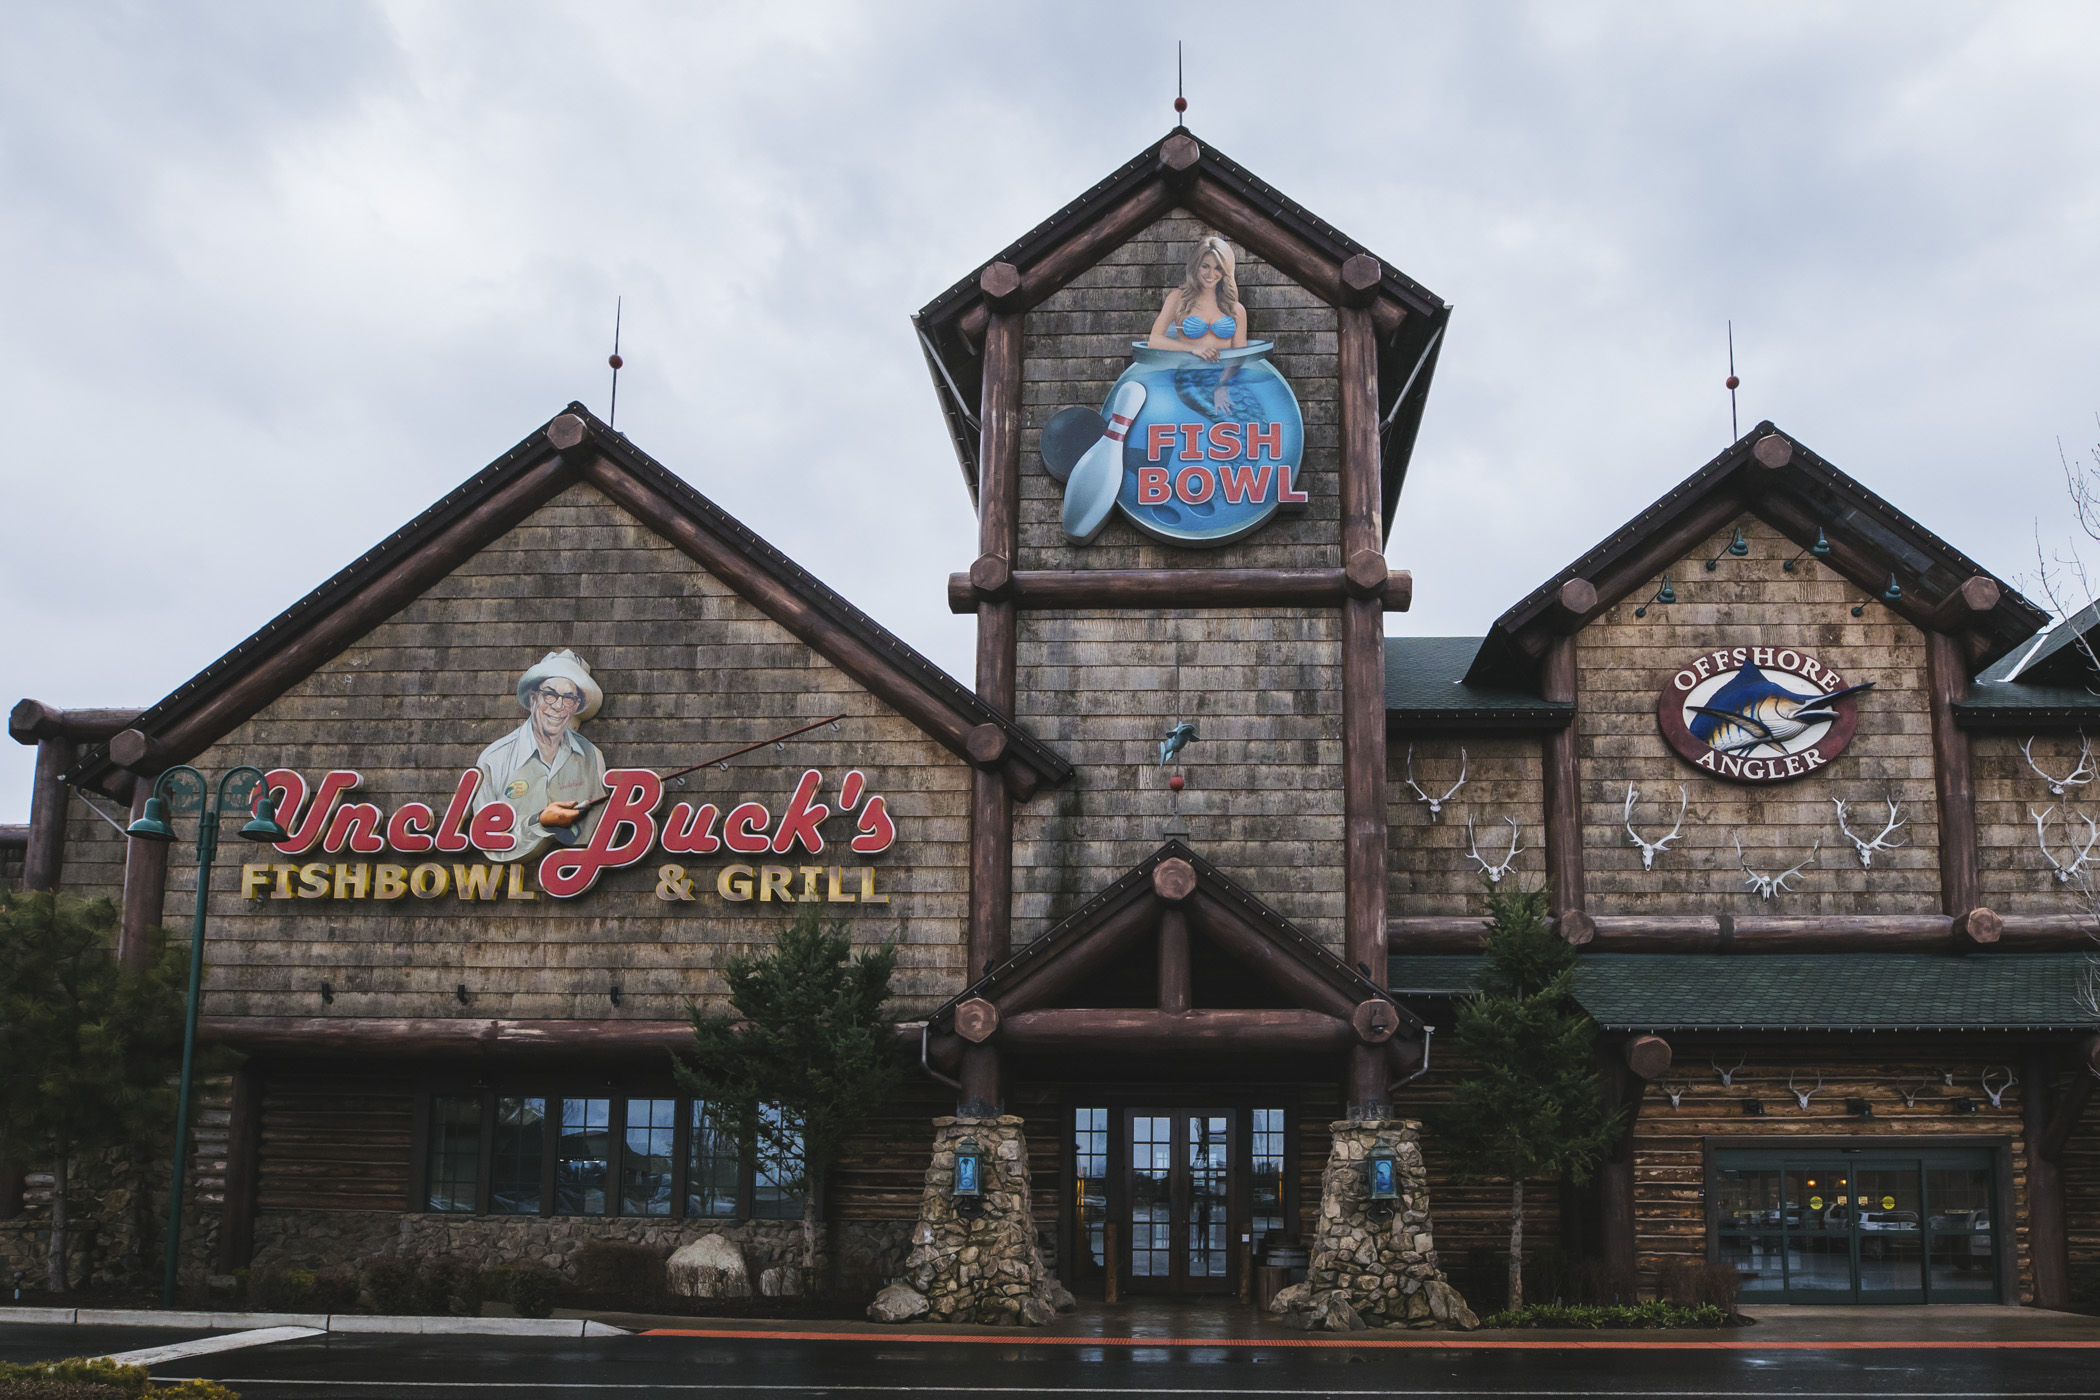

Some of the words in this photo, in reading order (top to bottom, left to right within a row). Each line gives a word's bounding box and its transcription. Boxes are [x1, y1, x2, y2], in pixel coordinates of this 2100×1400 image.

[1147, 422, 1283, 461] FISH
[1137, 465, 1309, 505] BOWL
[1673, 646, 1842, 693] OFFSHORE
[1695, 748, 1827, 780] ANGLER
[250, 768, 518, 855] Uncle
[539, 768, 897, 898] Buck's
[241, 862, 537, 901] FISHBOWL
[655, 863, 698, 901] &
[717, 864, 890, 903] GRILL
